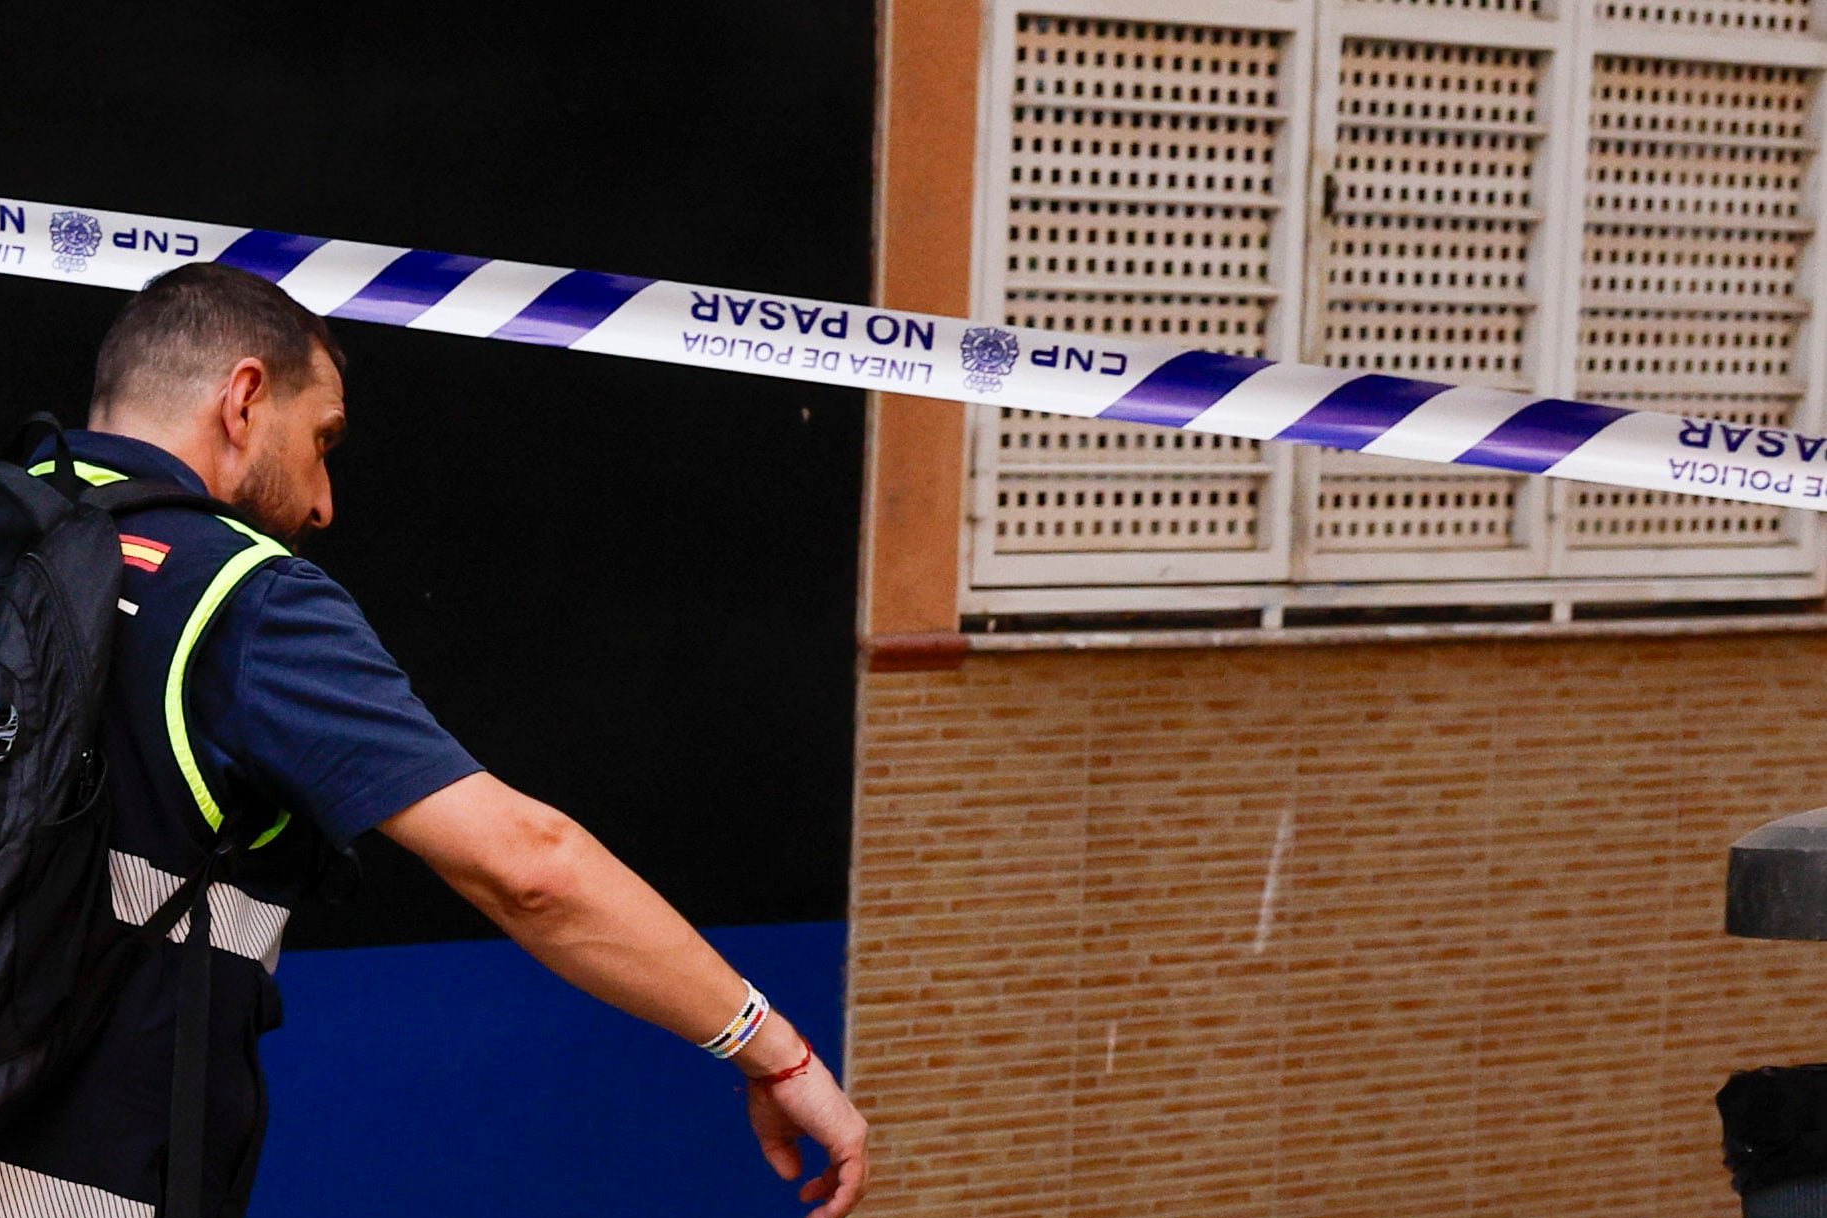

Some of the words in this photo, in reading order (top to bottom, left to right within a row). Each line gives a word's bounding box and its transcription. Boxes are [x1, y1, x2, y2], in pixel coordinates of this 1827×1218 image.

[112, 227, 199, 257] CNP
[689, 291, 849, 340] PASAR
[681, 331, 795, 366] POLICIA
[865, 315, 935, 351] NO
[802, 346, 841, 372] DE
[848, 353, 934, 385] LINEA
[1030, 343, 1128, 377] CNP
[1677, 418, 1827, 463] ASAR
[1668, 456, 1795, 494] POLICIA
[1802, 475, 1827, 499] E
